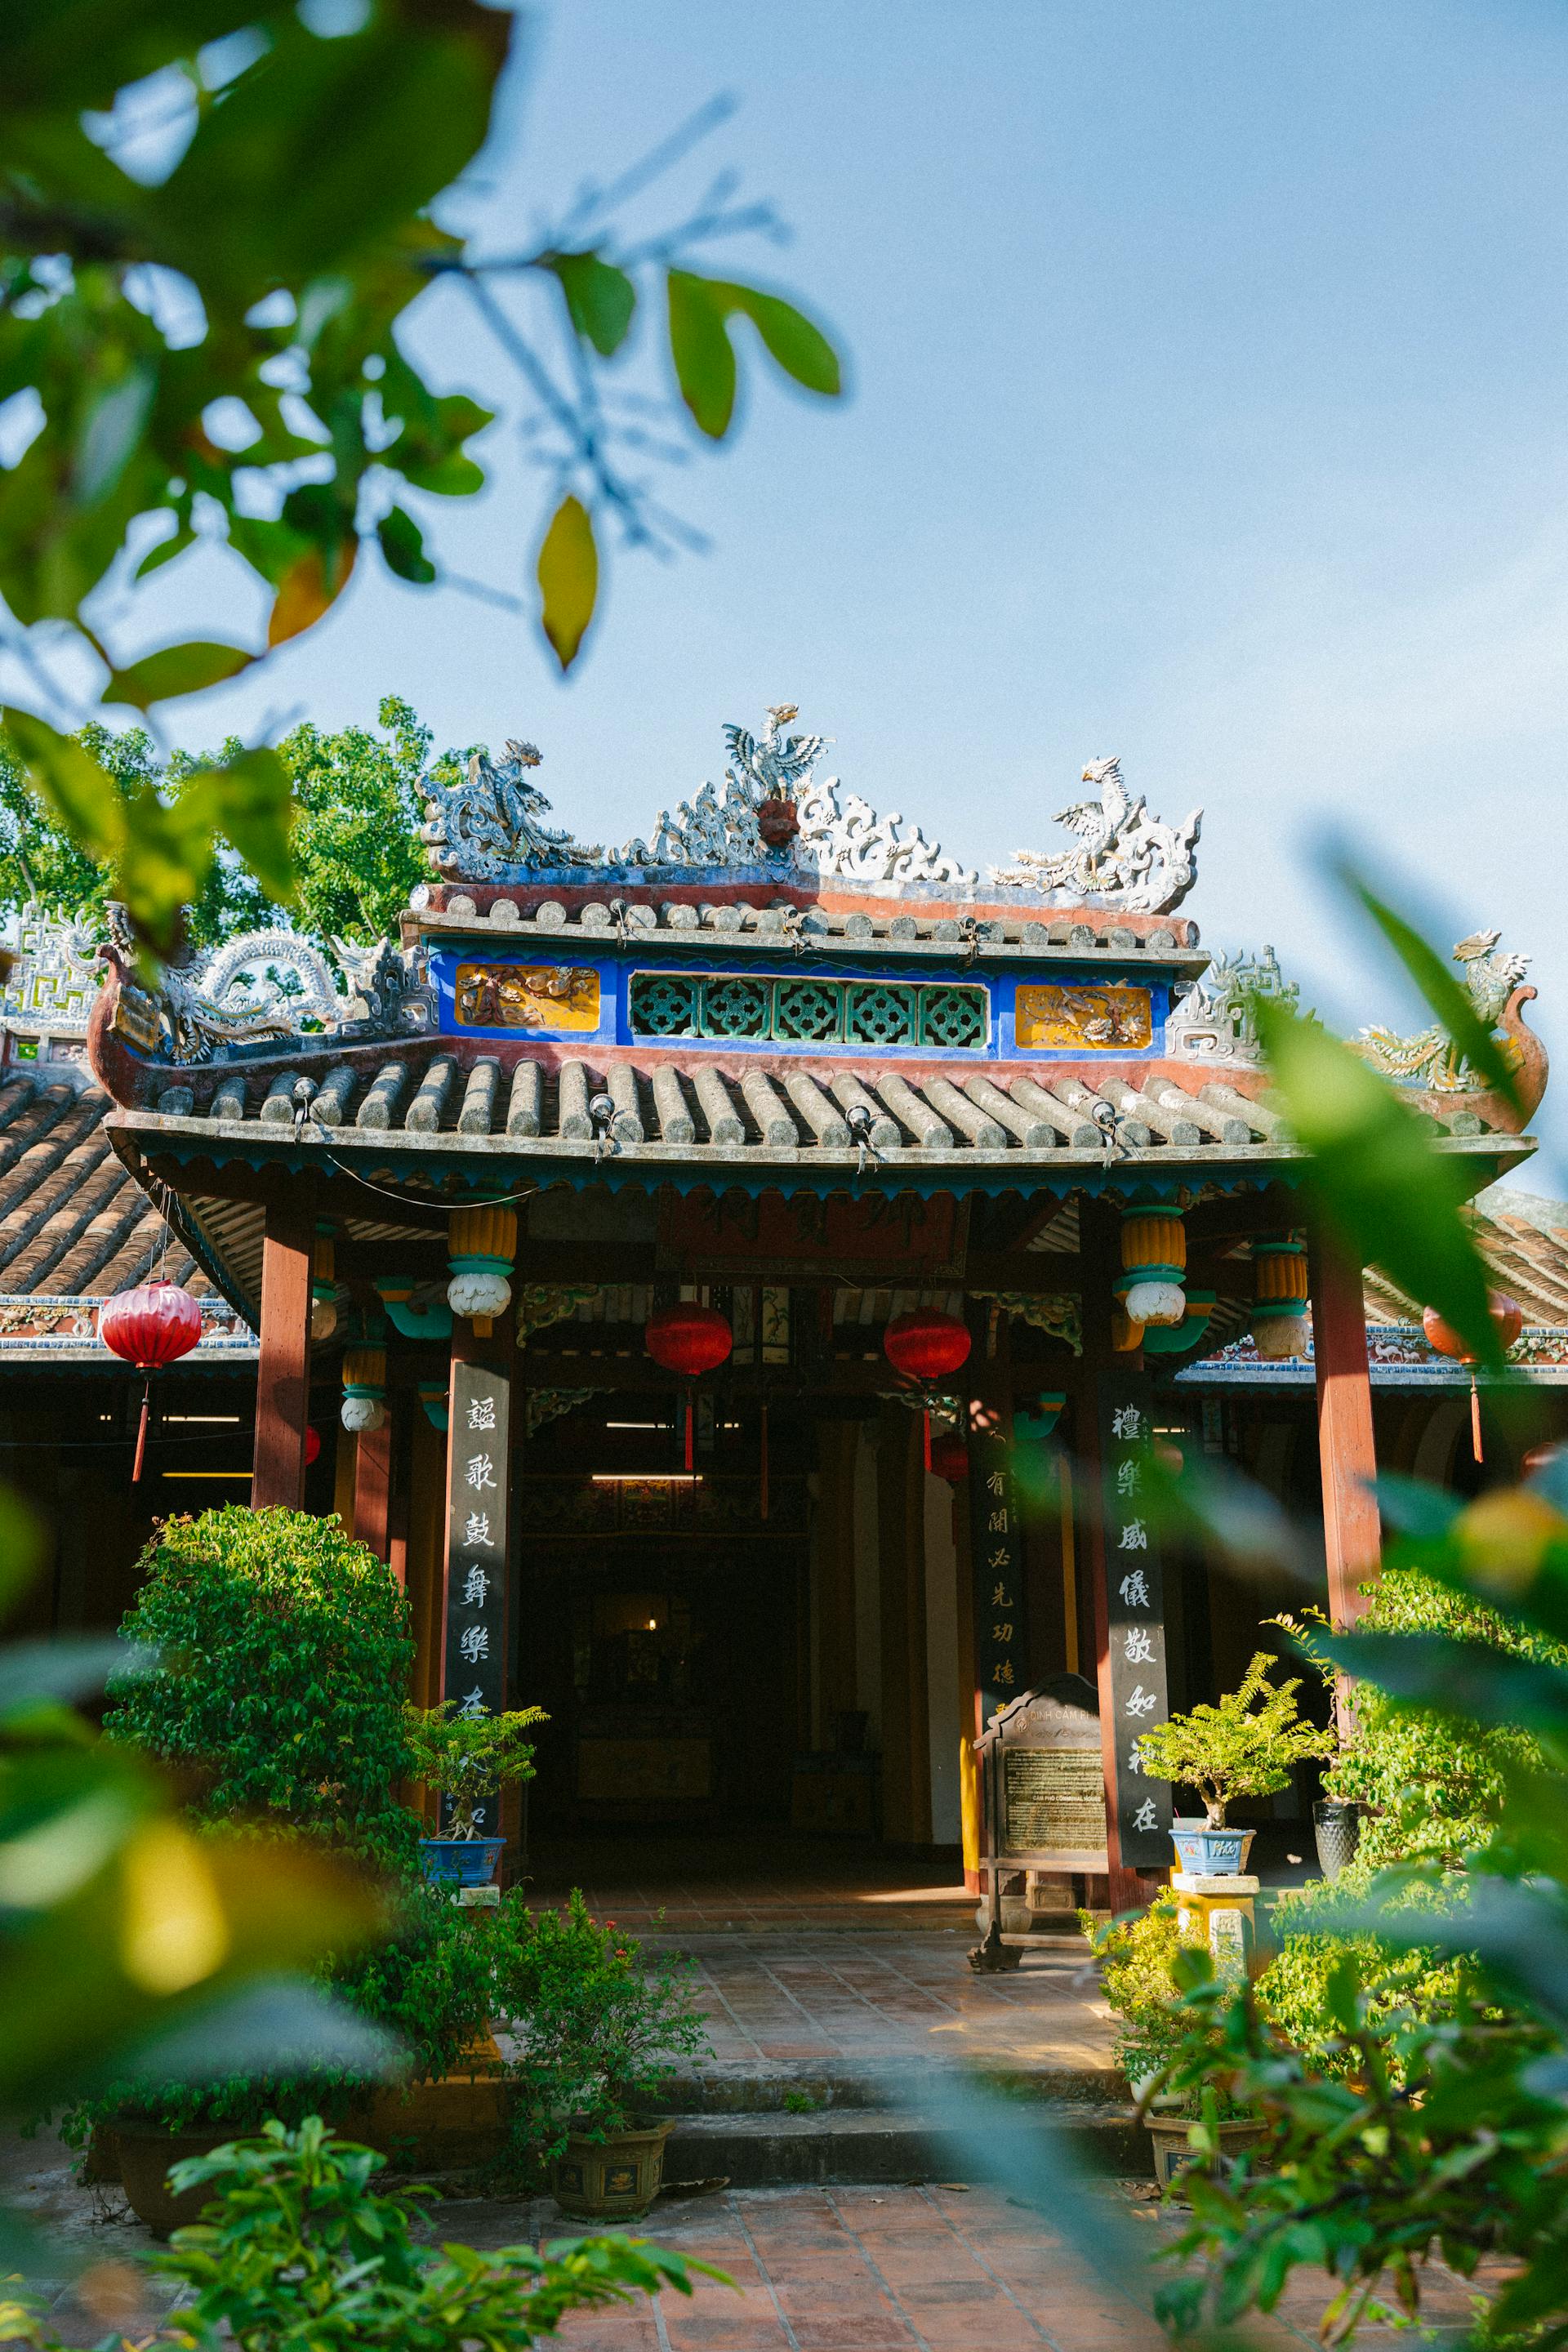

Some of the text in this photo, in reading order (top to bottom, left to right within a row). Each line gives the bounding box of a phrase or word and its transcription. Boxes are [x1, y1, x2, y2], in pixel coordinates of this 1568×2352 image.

[986, 1471, 1015, 1713] 有開必先功德
